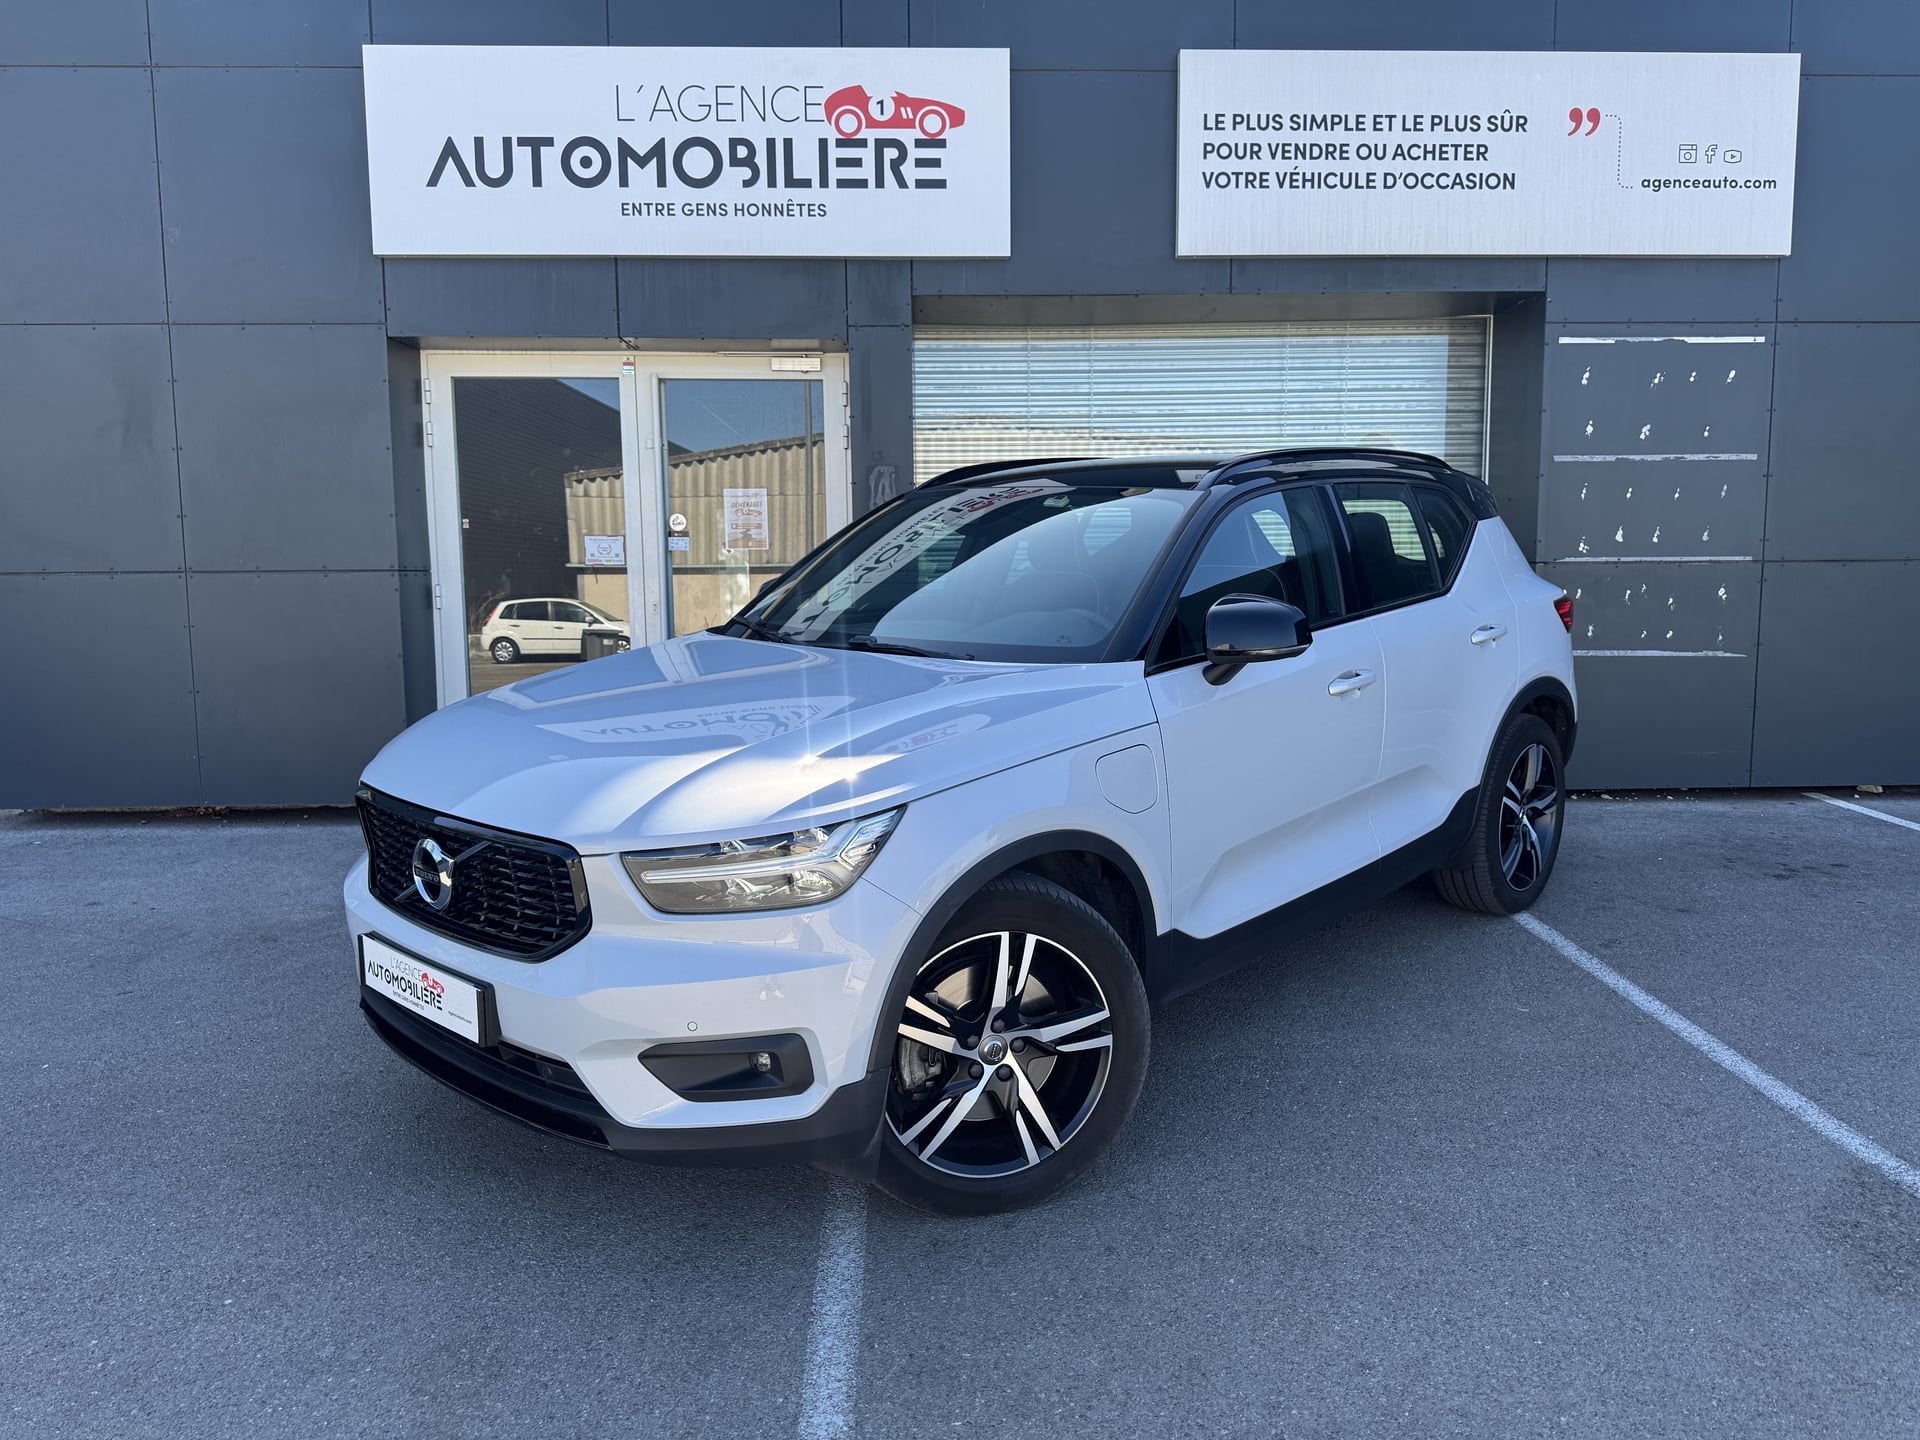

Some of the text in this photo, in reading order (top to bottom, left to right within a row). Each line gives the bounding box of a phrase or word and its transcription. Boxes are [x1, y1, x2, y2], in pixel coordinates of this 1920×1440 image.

[1203, 109, 1528, 133] LE PLUS SIMPLE ET LE PLUS SÛR
[1202, 142, 1489, 162] POUR VENDRE OU ACHETER
[1201, 165, 1516, 190] VOTRE VÉHICULE D'OCCASION
[1641, 176, 1777, 193] agenceauto.com
[621, 198, 827, 218] ENTRE GENS HONNÊTES
